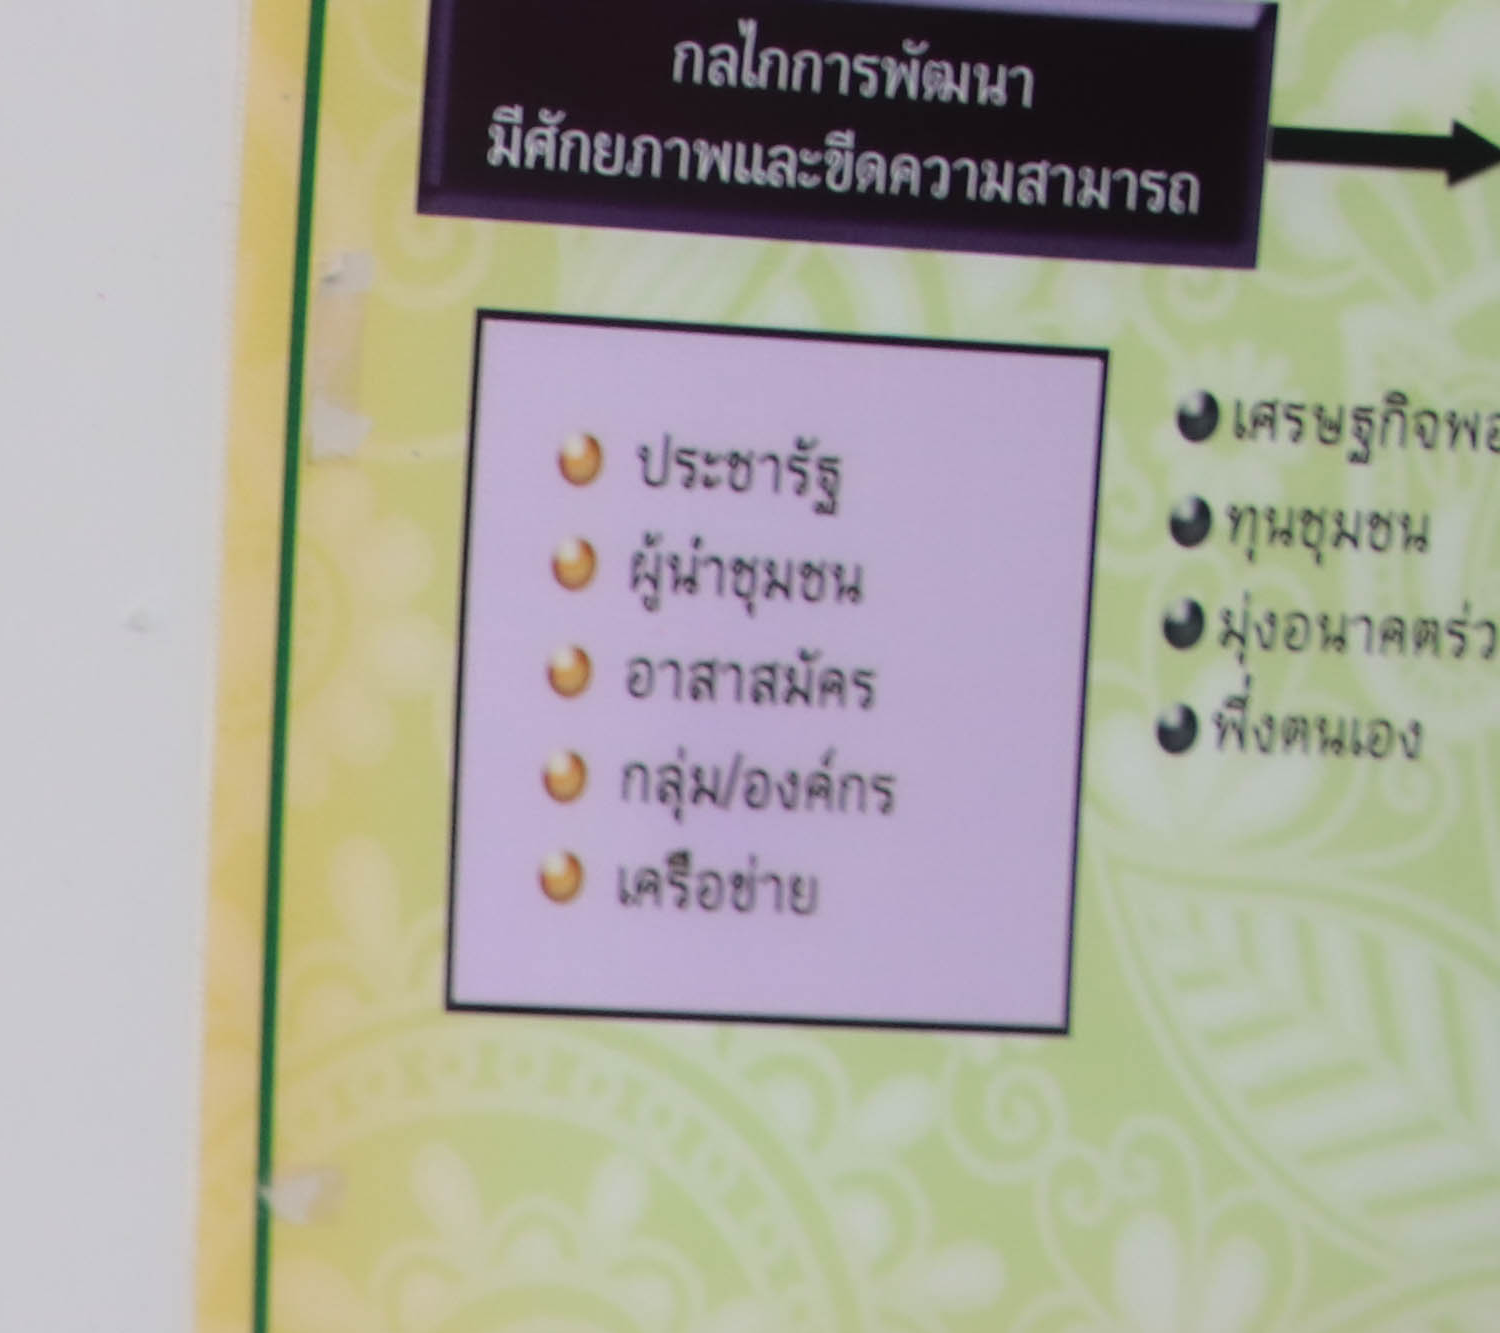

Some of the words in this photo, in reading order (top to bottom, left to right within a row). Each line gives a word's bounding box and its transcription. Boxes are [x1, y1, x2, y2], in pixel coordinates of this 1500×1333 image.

[673, 20, 1036, 108] กลไกการพัฒนา
[486, 104, 1202, 215] มีศักยภาพและขีดความสามารถ
[638, 433, 843, 516] ประชารัฐ
[629, 532, 864, 618] ผู้นำชุมชน
[1226, 504, 1430, 566] ทุนชุมชน
[626, 647, 877, 710] อาสาสมัคร
[1213, 673, 1425, 760] พึ่งตนเอง
[621, 746, 897, 823] กลุ่ม/องค์กร
[617, 849, 819, 916] เครือข่าย
